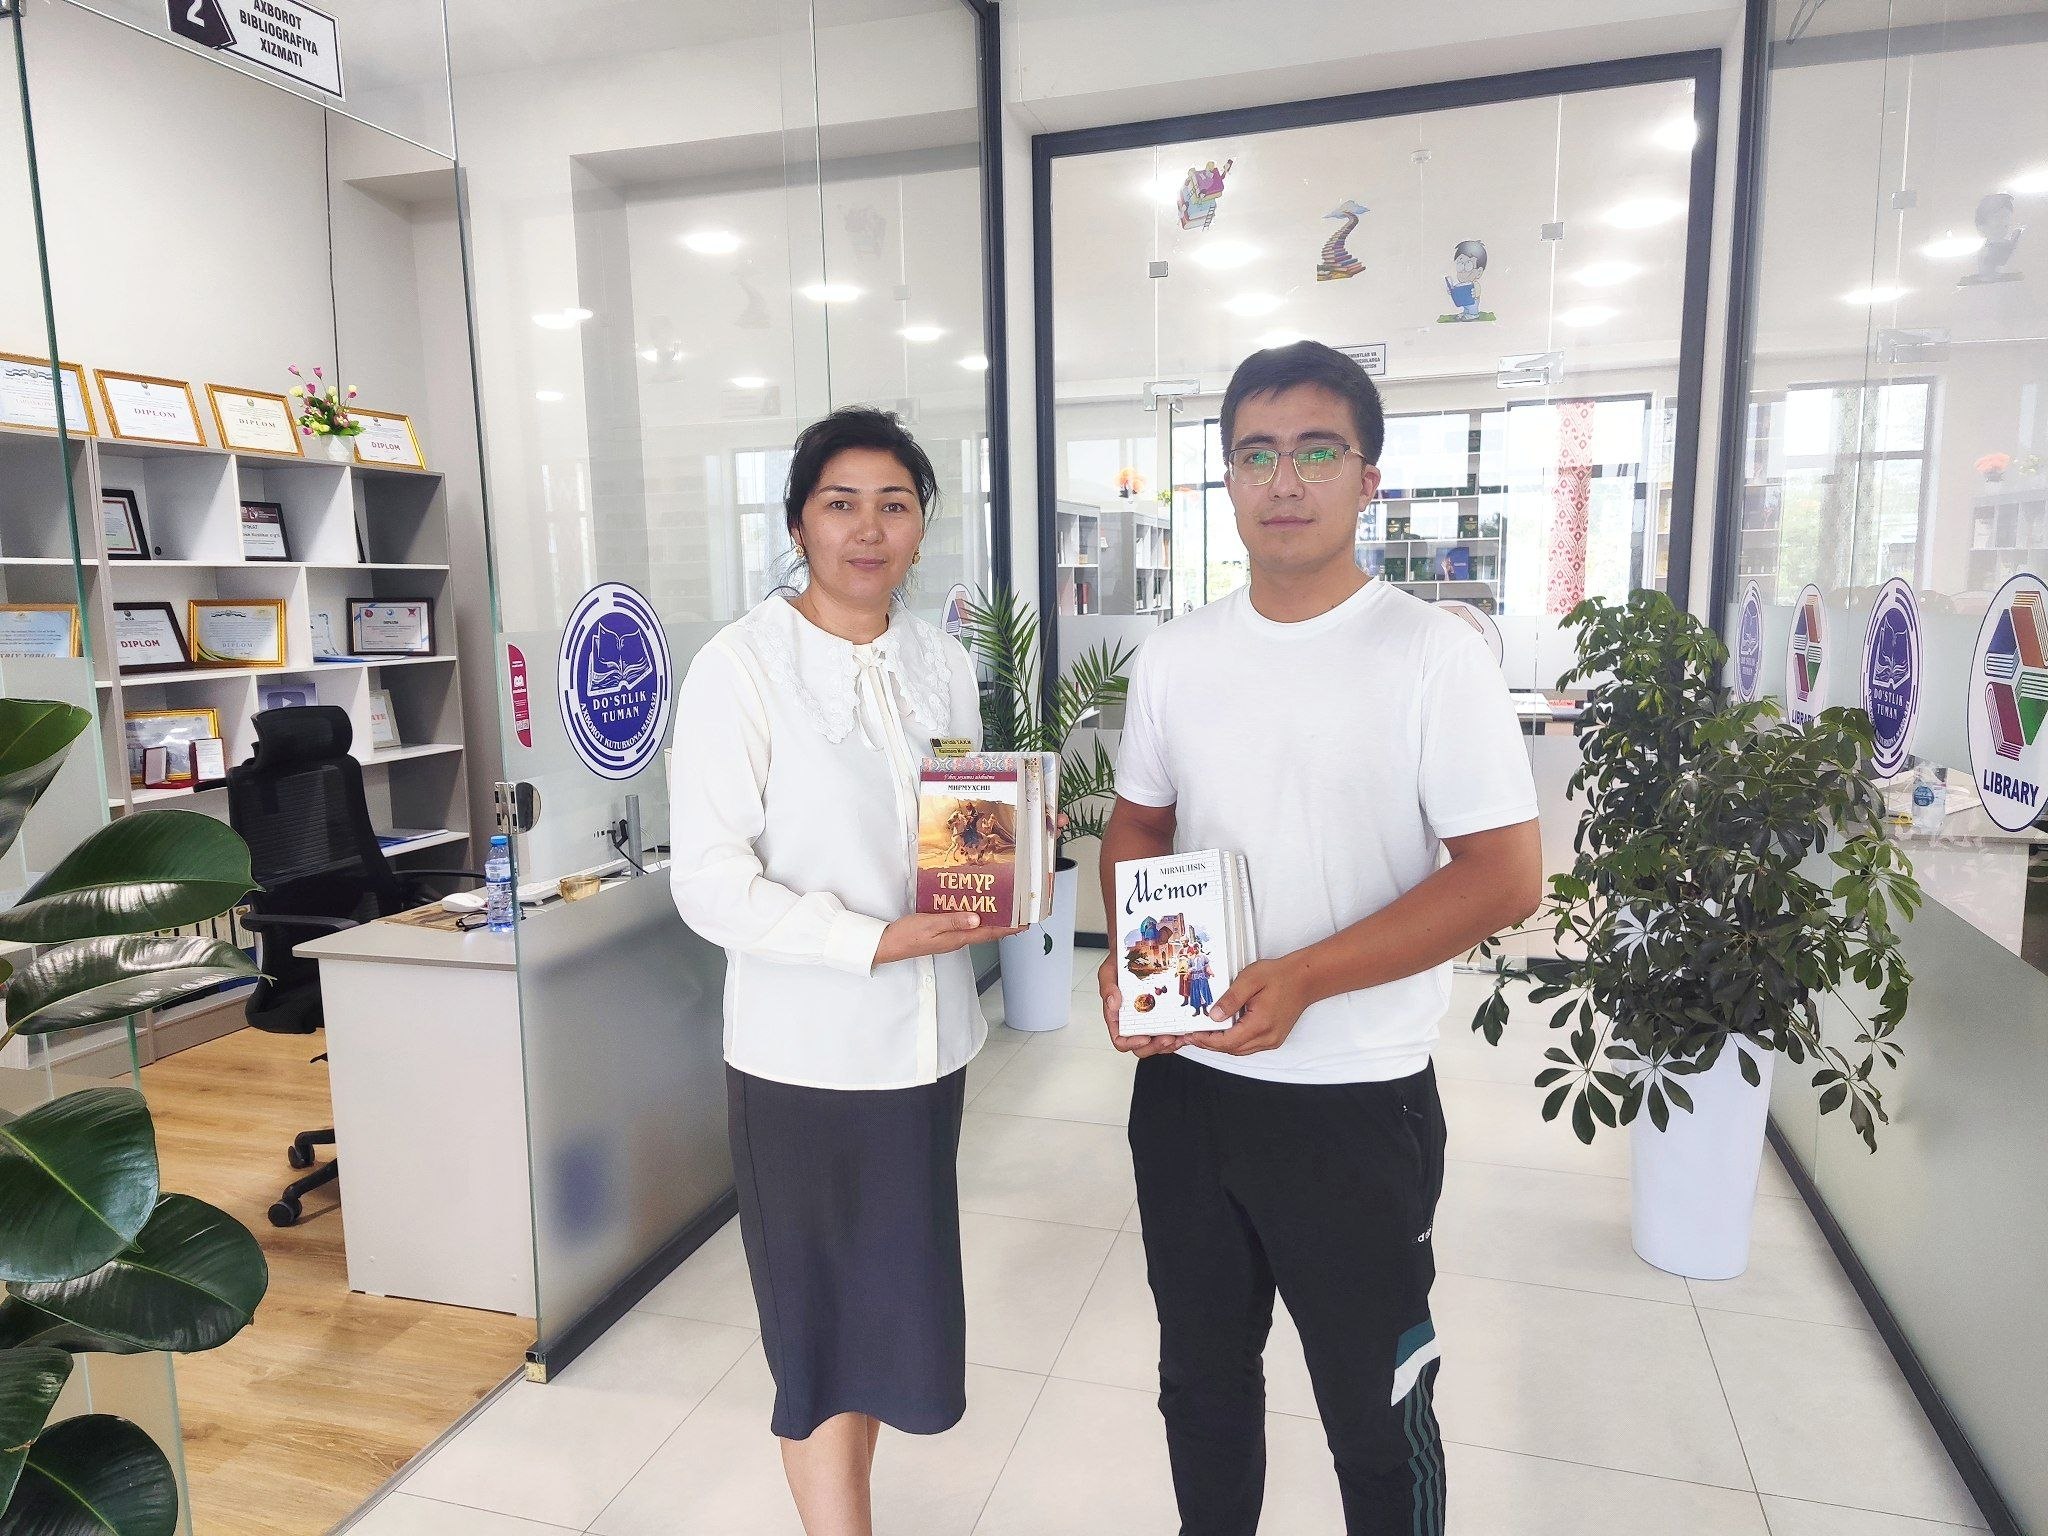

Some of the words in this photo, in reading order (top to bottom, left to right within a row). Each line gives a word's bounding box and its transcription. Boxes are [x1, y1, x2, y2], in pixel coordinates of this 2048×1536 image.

[253, 0, 302, 30] AXBOROT
[239, 9, 319, 57] BIBLIOGRAFIYA
[260, 37, 303, 68] XIZMATI
[134, 407, 177, 419] DIPLOM
[238, 417, 277, 429] DIPLOM
[371, 441, 401, 451] DIPLOM
[121, 639, 161, 648] DIPLOM
[602, 706, 640, 723] TUMAN
[1877, 704, 1898, 720] TUMAN
[1983, 769, 2040, 807] LIBRARY
[1160, 862, 1206, 875] MIRMUHSIN
[937, 872, 995, 894] ТЕМУР
[933, 894, 998, 913] МАЛИК
